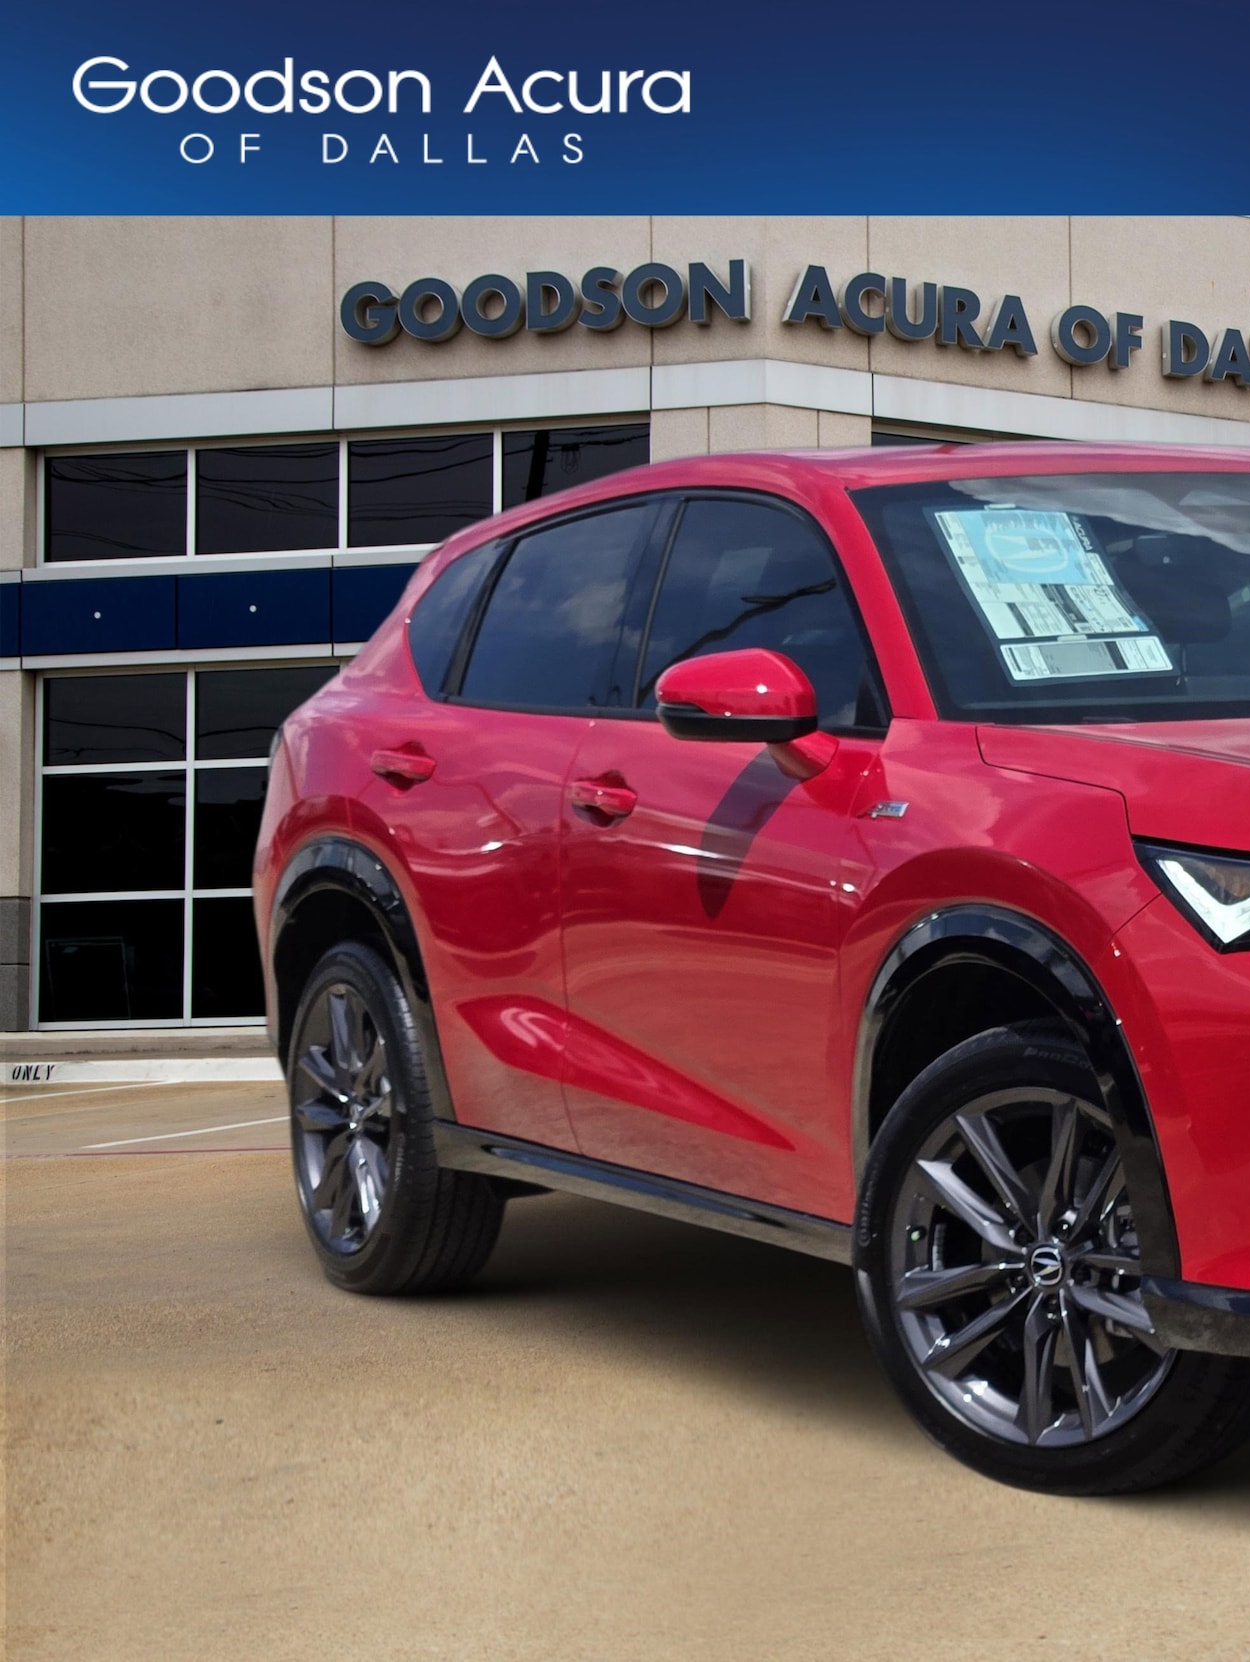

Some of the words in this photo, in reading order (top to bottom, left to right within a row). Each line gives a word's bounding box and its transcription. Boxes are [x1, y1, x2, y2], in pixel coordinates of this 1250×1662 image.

[340, 258, 751, 346] GOODSON
[782, 264, 1038, 357] ACURA
[1050, 304, 1144, 370] OF
[12, 1064, 55, 1081] ONLY
